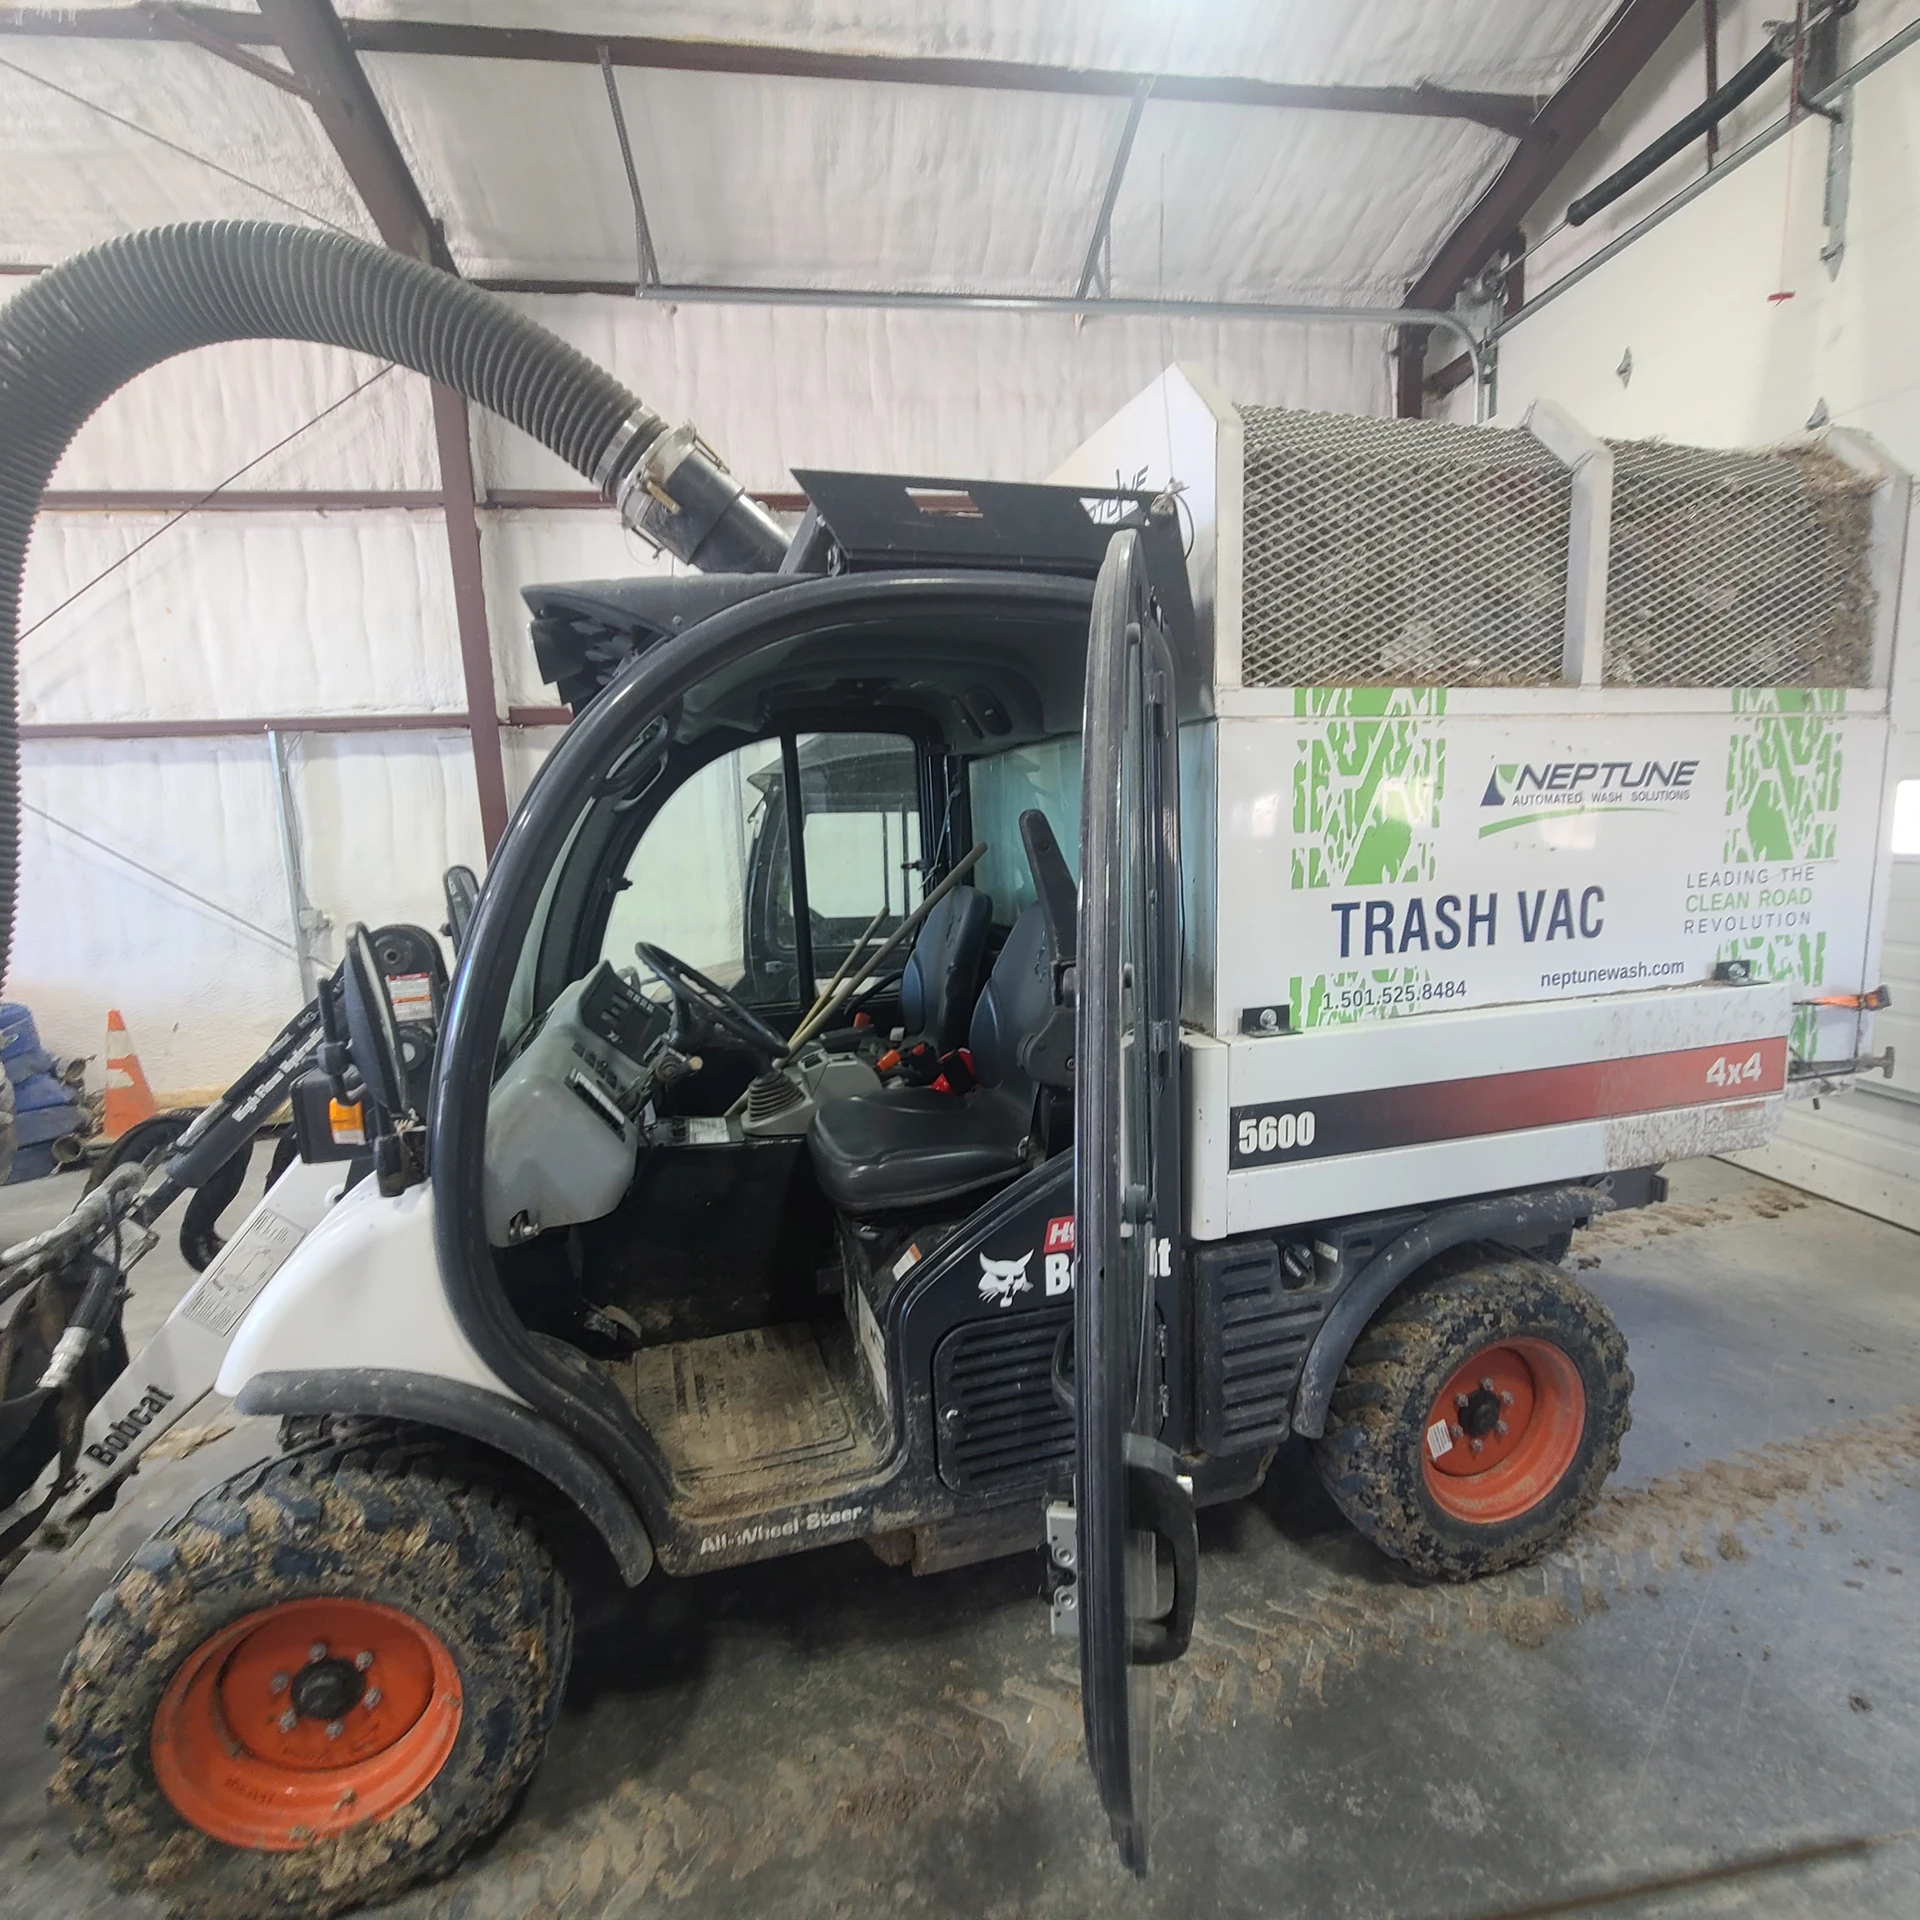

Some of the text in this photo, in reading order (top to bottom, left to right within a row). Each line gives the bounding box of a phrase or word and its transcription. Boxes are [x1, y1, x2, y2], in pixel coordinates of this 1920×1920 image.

[1515, 760, 1701, 791] NEPTUNE
[1512, 788, 1691, 806] AUTOMATED WASH SOLUTIONS
[1686, 865, 1816, 889] LEADING THE
[1685, 887, 1813, 913] CLEAN ROAD
[1331, 885, 1606, 958] TRASH VAC
[1684, 911, 1812, 934] REVOLUTION
[1541, 960, 1685, 990] neptunewash.com
[1323, 979, 1467, 1011] 1.501.525.8484
[1706, 1051, 1763, 1088] 4x4
[1238, 1110, 1316, 1154] 5600
[83, 1384, 175, 1468] Bobcat
[805, 1506, 863, 1531] Steer
